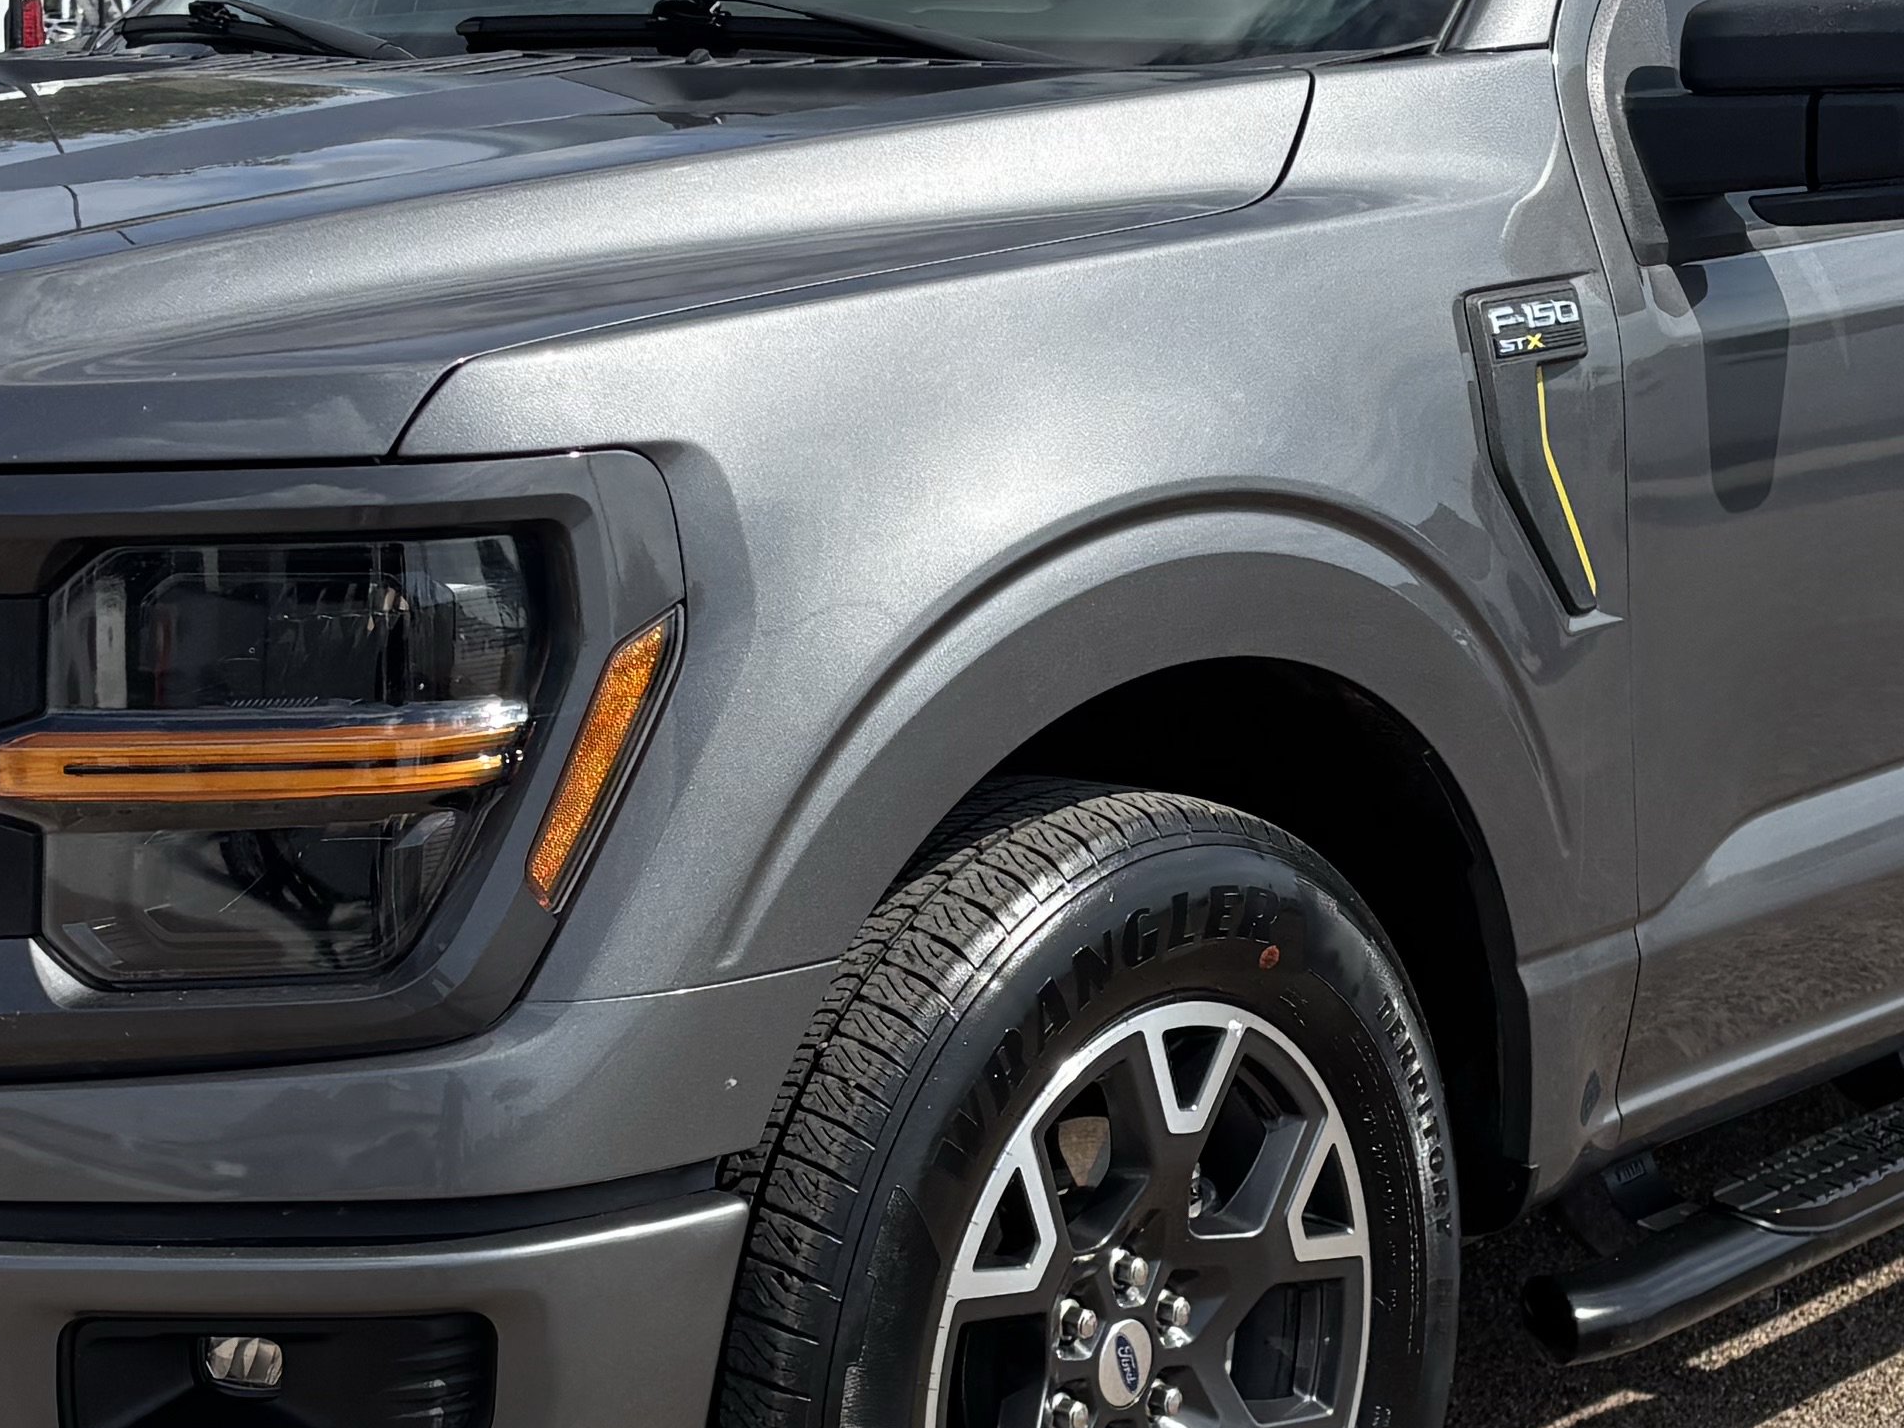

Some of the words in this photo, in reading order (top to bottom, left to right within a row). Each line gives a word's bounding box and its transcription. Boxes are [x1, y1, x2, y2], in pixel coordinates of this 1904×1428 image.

[1487, 299, 1580, 334] F-150
[1499, 333, 1546, 354] STX
[929, 884, 1281, 1174] WRANGLER
[1376, 993, 1453, 1238] TERRITORY
[1117, 1346, 1137, 1385] Ford
